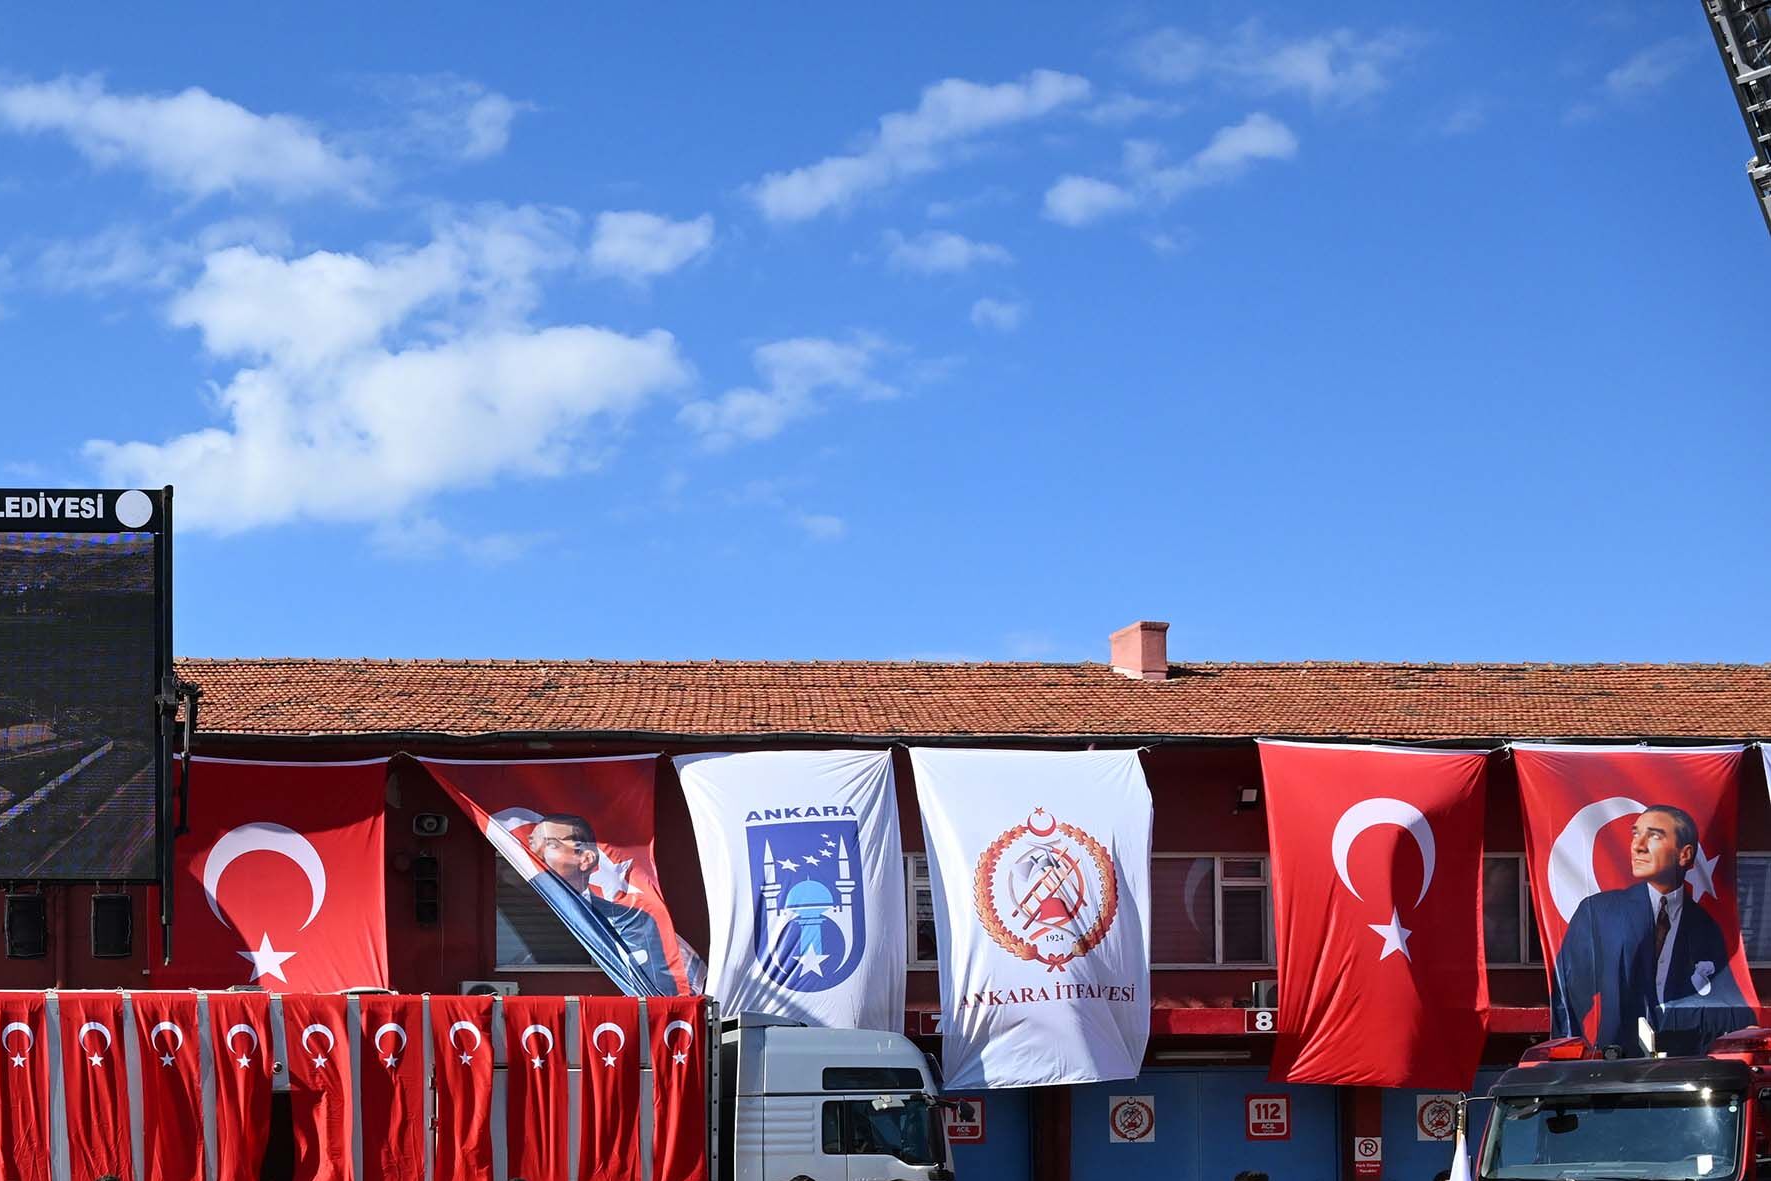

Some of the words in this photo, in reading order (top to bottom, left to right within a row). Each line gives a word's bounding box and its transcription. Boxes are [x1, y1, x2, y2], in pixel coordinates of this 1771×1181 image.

[745, 805, 857, 823] ANKARA
[1045, 933, 1065, 942] 1924
[1255, 1011, 1274, 1031] 8
[1255, 1103, 1281, 1120] 112
